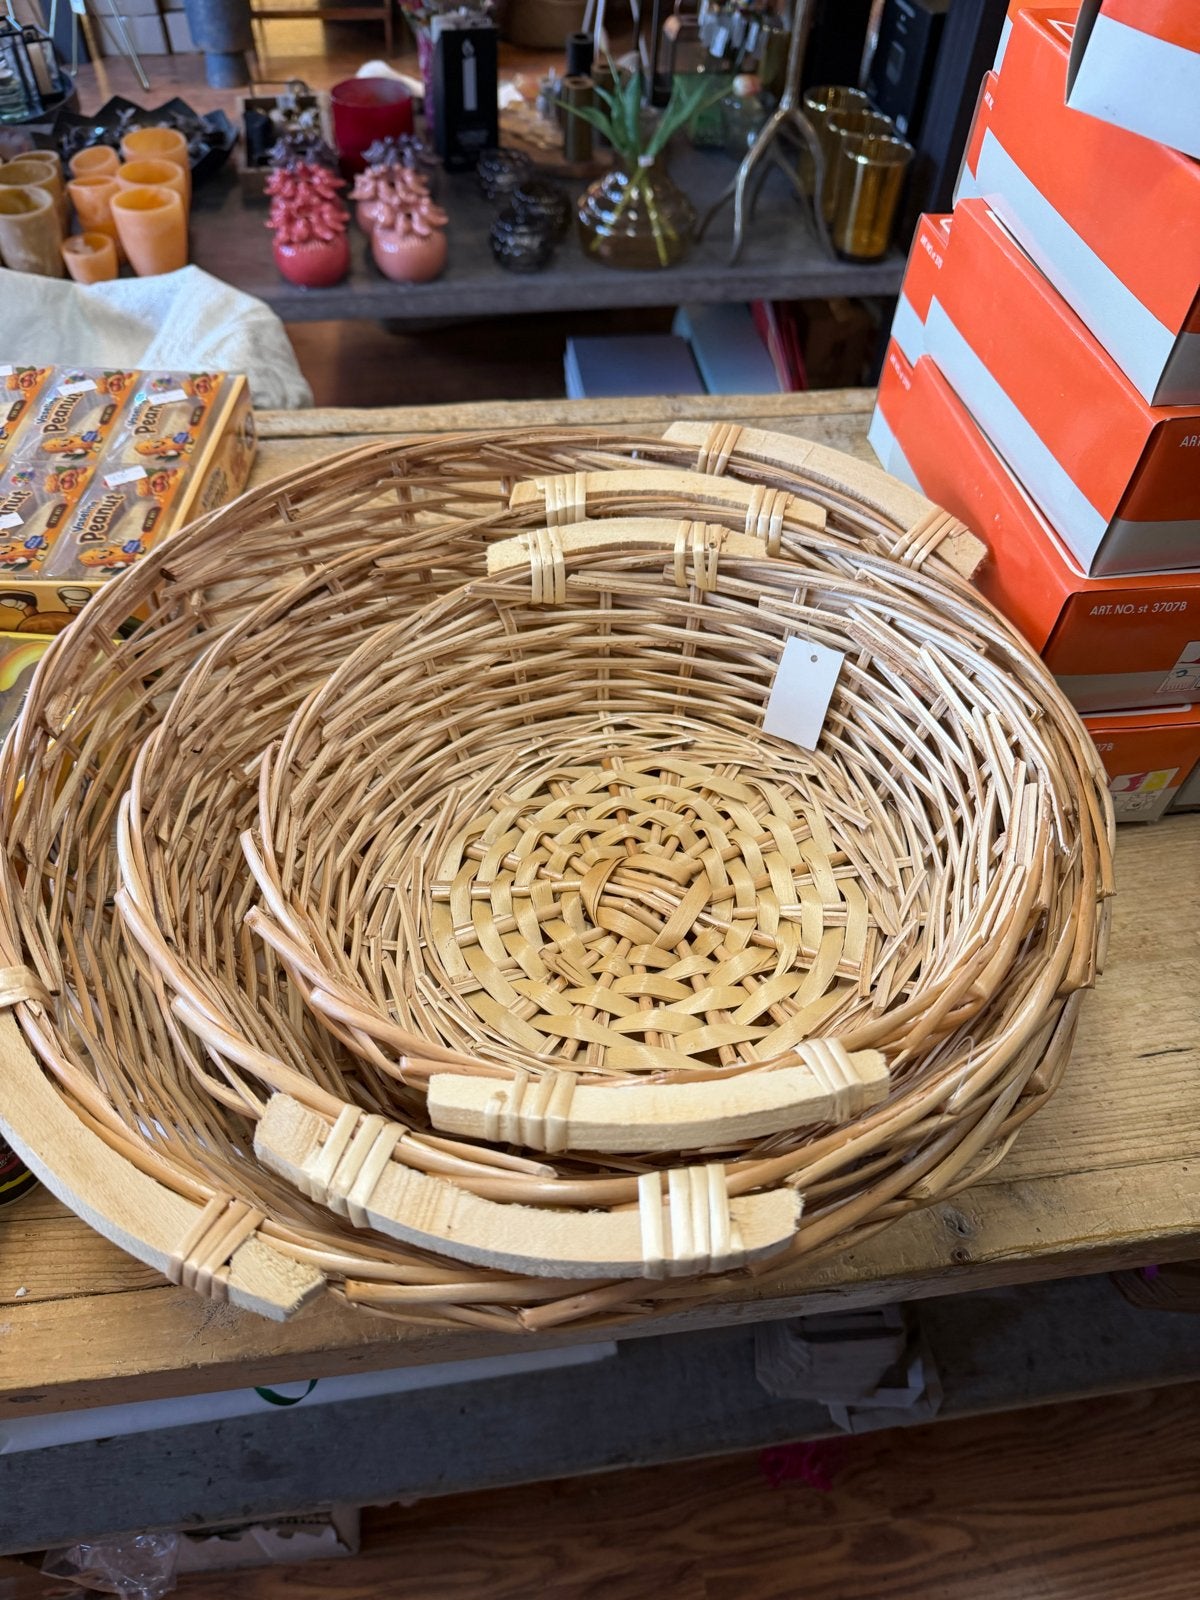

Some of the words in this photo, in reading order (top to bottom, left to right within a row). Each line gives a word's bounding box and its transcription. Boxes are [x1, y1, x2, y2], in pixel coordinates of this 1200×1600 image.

[1179, 435, 1200, 447] AR
[80, 494, 124, 542] Peanut
[1089, 604, 1112, 616] ART.
[1113, 604, 1135, 615] NO.
[1137, 604, 1148, 614] st
